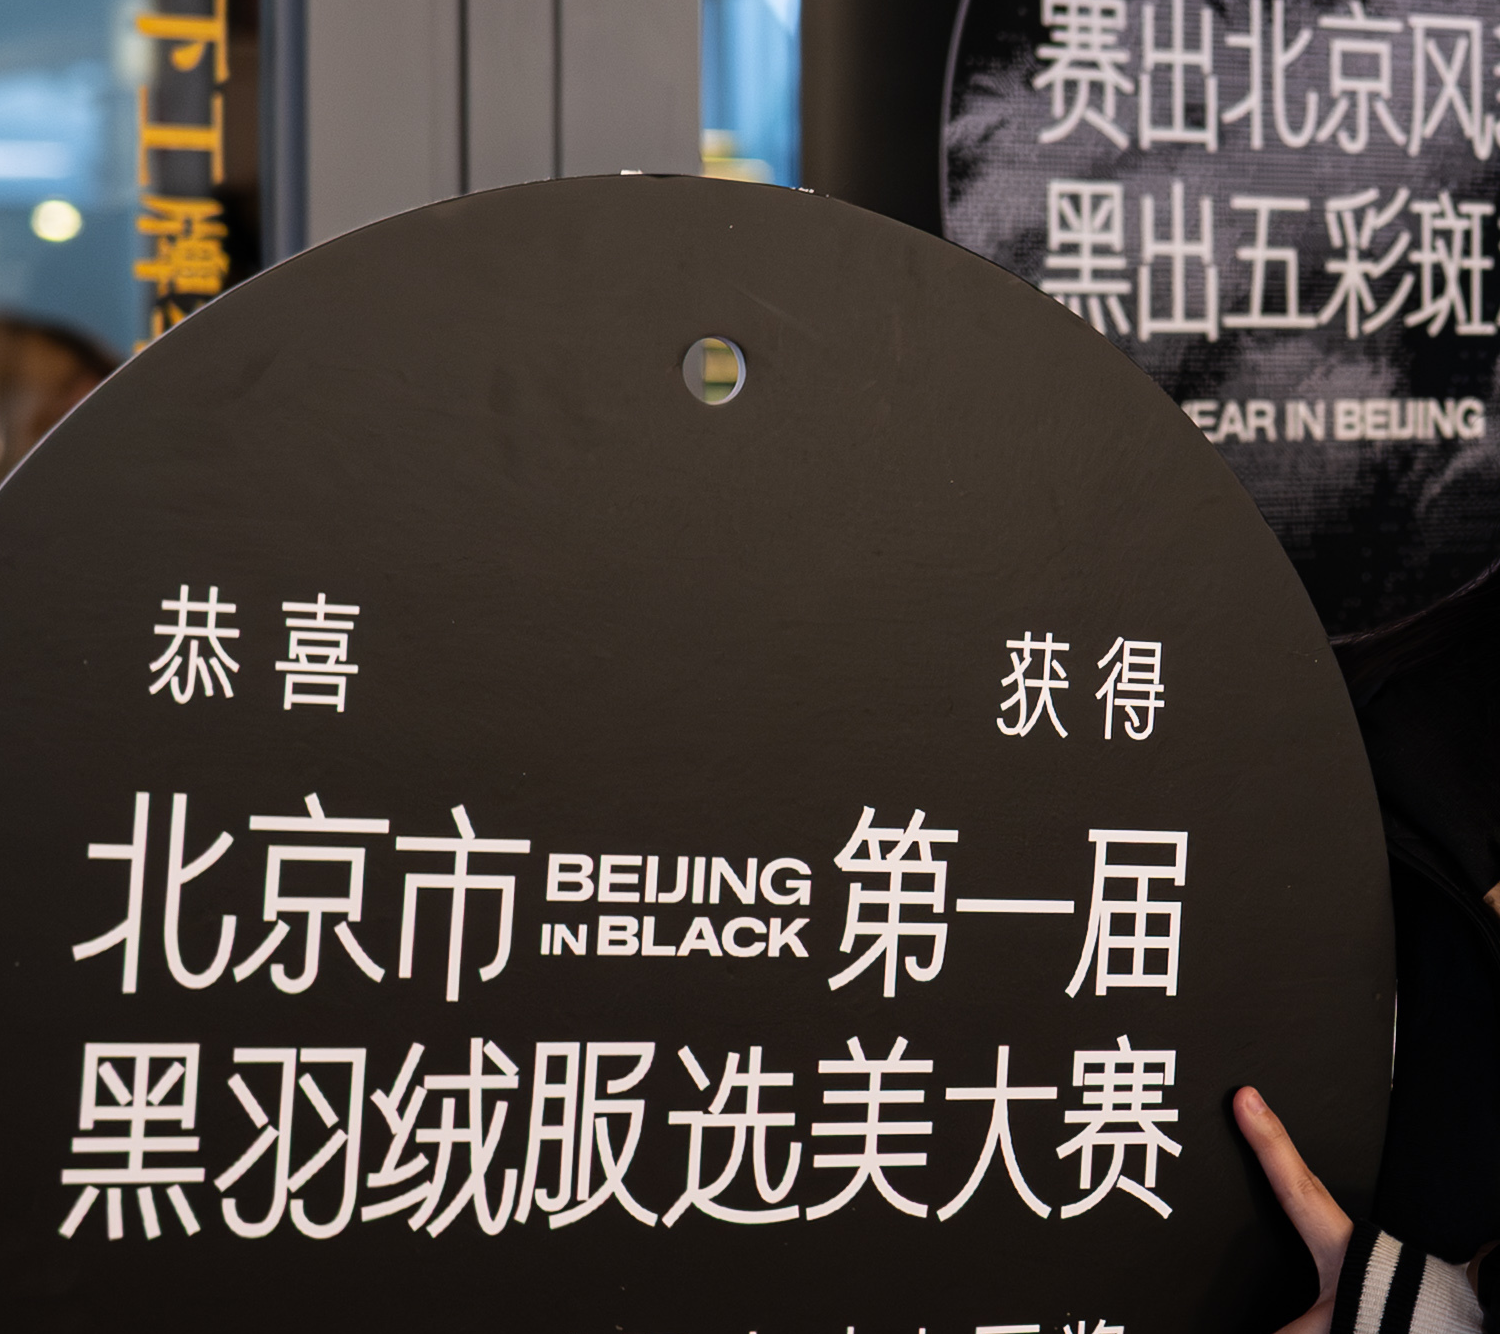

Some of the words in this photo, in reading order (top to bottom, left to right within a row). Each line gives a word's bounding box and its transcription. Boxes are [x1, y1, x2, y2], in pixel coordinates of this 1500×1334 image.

[1182, 398, 1278, 445] EAR
[1285, 398, 1326, 443] IN
[1334, 396, 1486, 442] BEIJING
[148, 583, 362, 714] 恭喜
[994, 630, 1167, 742] 获得
[70, 791, 533, 1004] 北京市
[544, 852, 814, 908] BEIJING
[827, 804, 1190, 1000] 第一届
[539, 922, 590, 958] IN
[595, 915, 811, 960] BLACK
[57, 1033, 1185, 1243] 黑羽绒服选美大赛
